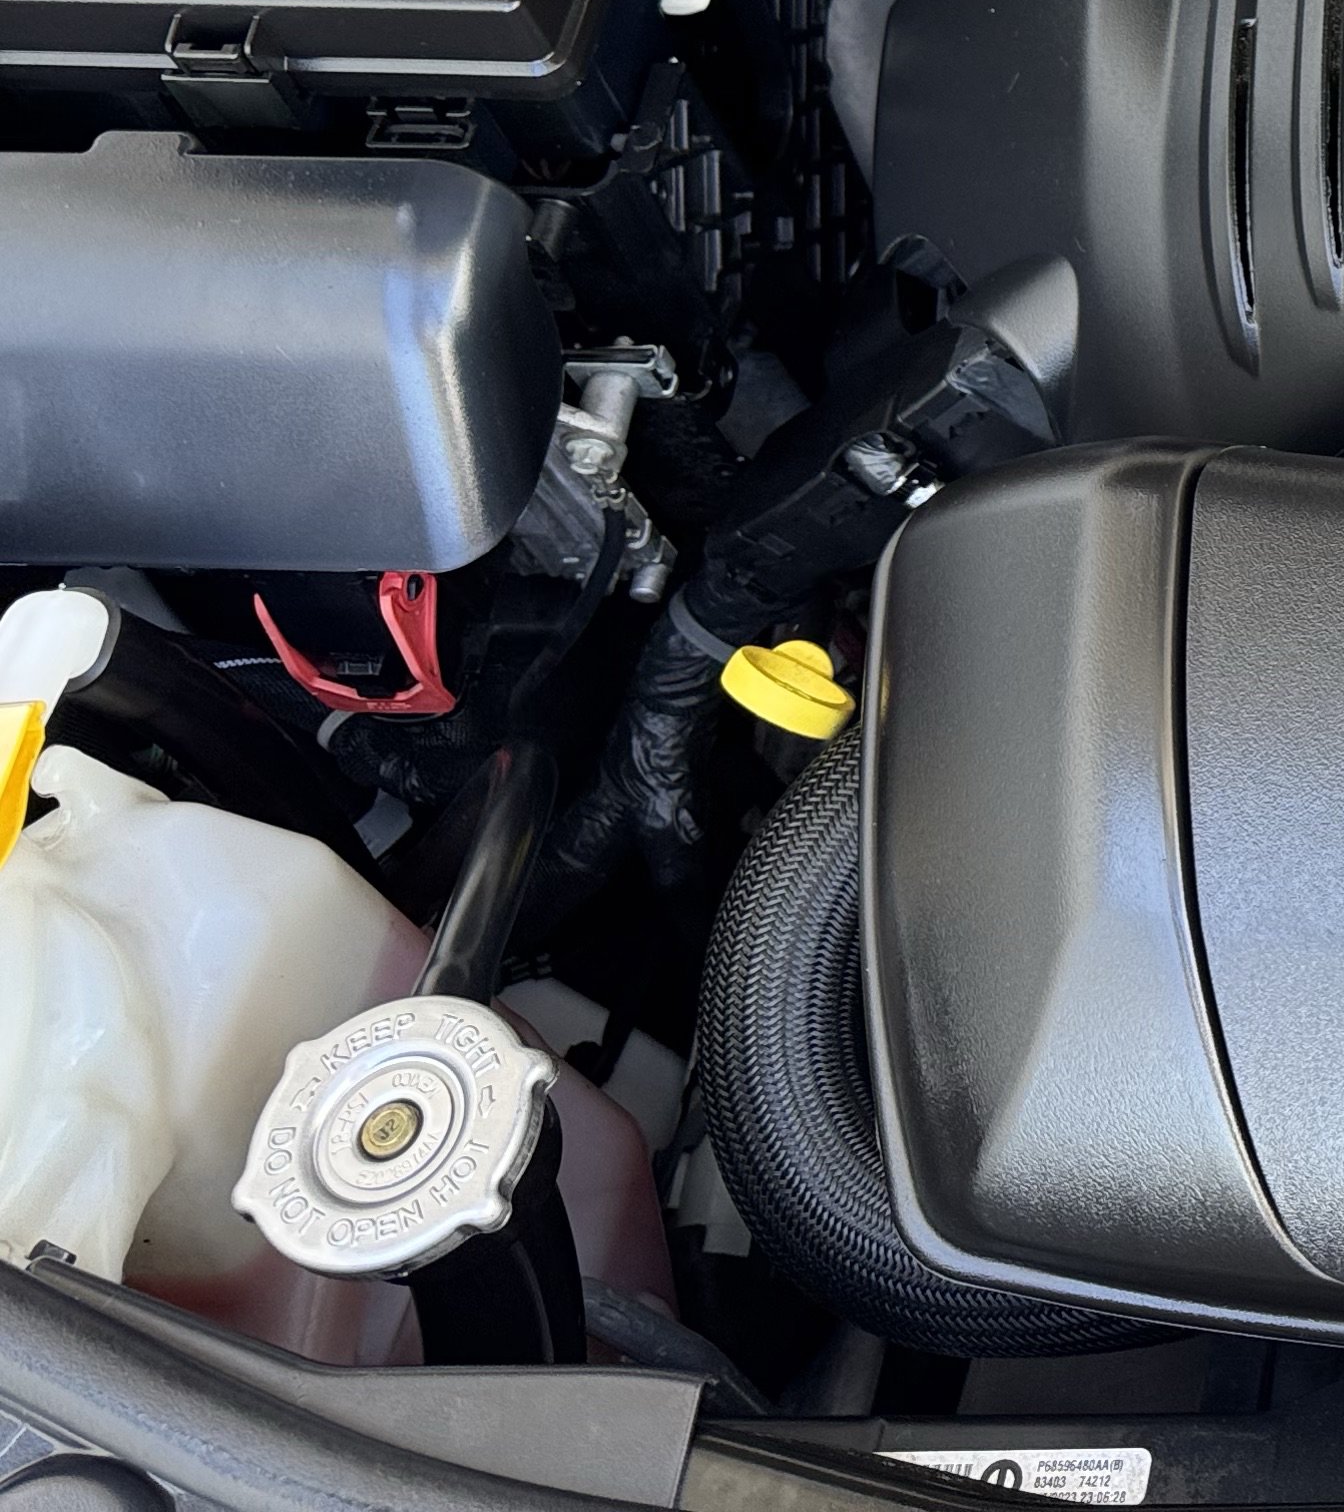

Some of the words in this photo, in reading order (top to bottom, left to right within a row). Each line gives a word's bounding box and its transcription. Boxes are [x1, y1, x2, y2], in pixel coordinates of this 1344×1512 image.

[319, 1012, 416, 1077] KEEP
[434, 1013, 502, 1077] TIGHT
[264, 1126, 297, 1176] DO
[431, 1138, 490, 1206] HOT
[268, 1177, 326, 1235] NOT
[326, 1199, 426, 1248] OPEN
